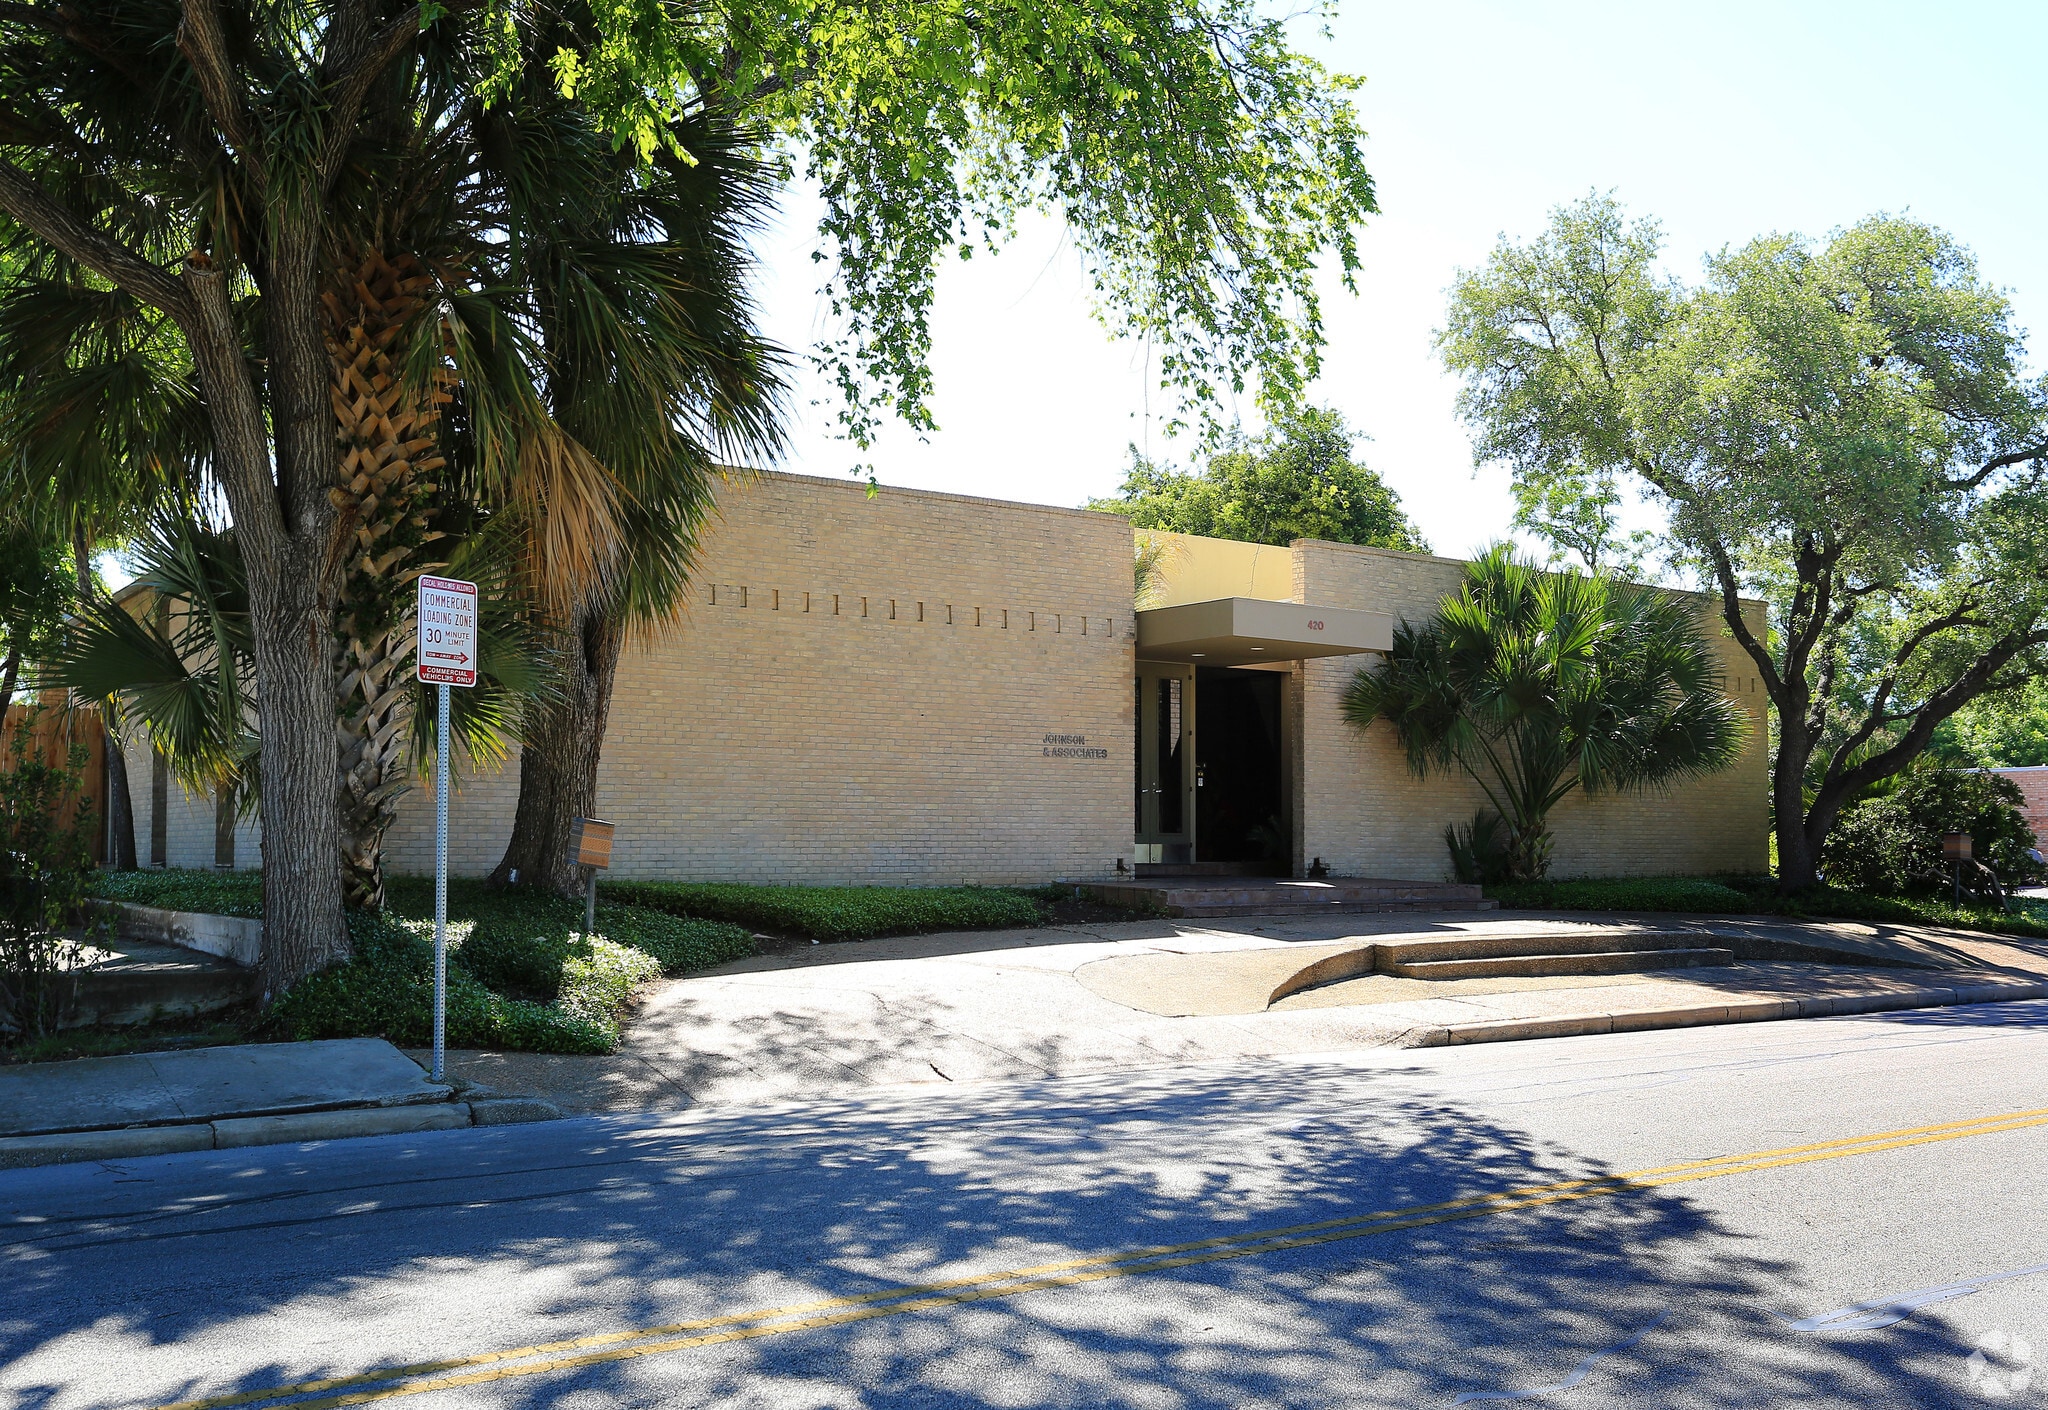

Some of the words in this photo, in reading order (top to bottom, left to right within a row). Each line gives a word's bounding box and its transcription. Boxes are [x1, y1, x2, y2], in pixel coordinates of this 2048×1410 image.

[423, 579, 436, 587] DECAL
[437, 581, 455, 590] HOLDRS
[456, 584, 474, 593] ALLOWED
[425, 592, 471, 611] COMMERCIAL
[423, 609, 451, 625] LOADING
[455, 614, 472, 628] ZONE
[1307, 620, 1324, 630] 420
[425, 628, 442, 643] 30
[445, 631, 470, 640] MINUTE
[426, 667, 468, 677] COMMERCIAL
[456, 676, 473, 684] ONLY
[1042, 734, 1085, 745] JOHNSON
[1042, 747, 1050, 757] &
[1051, 747, 1108, 759] ASSOCIATES
